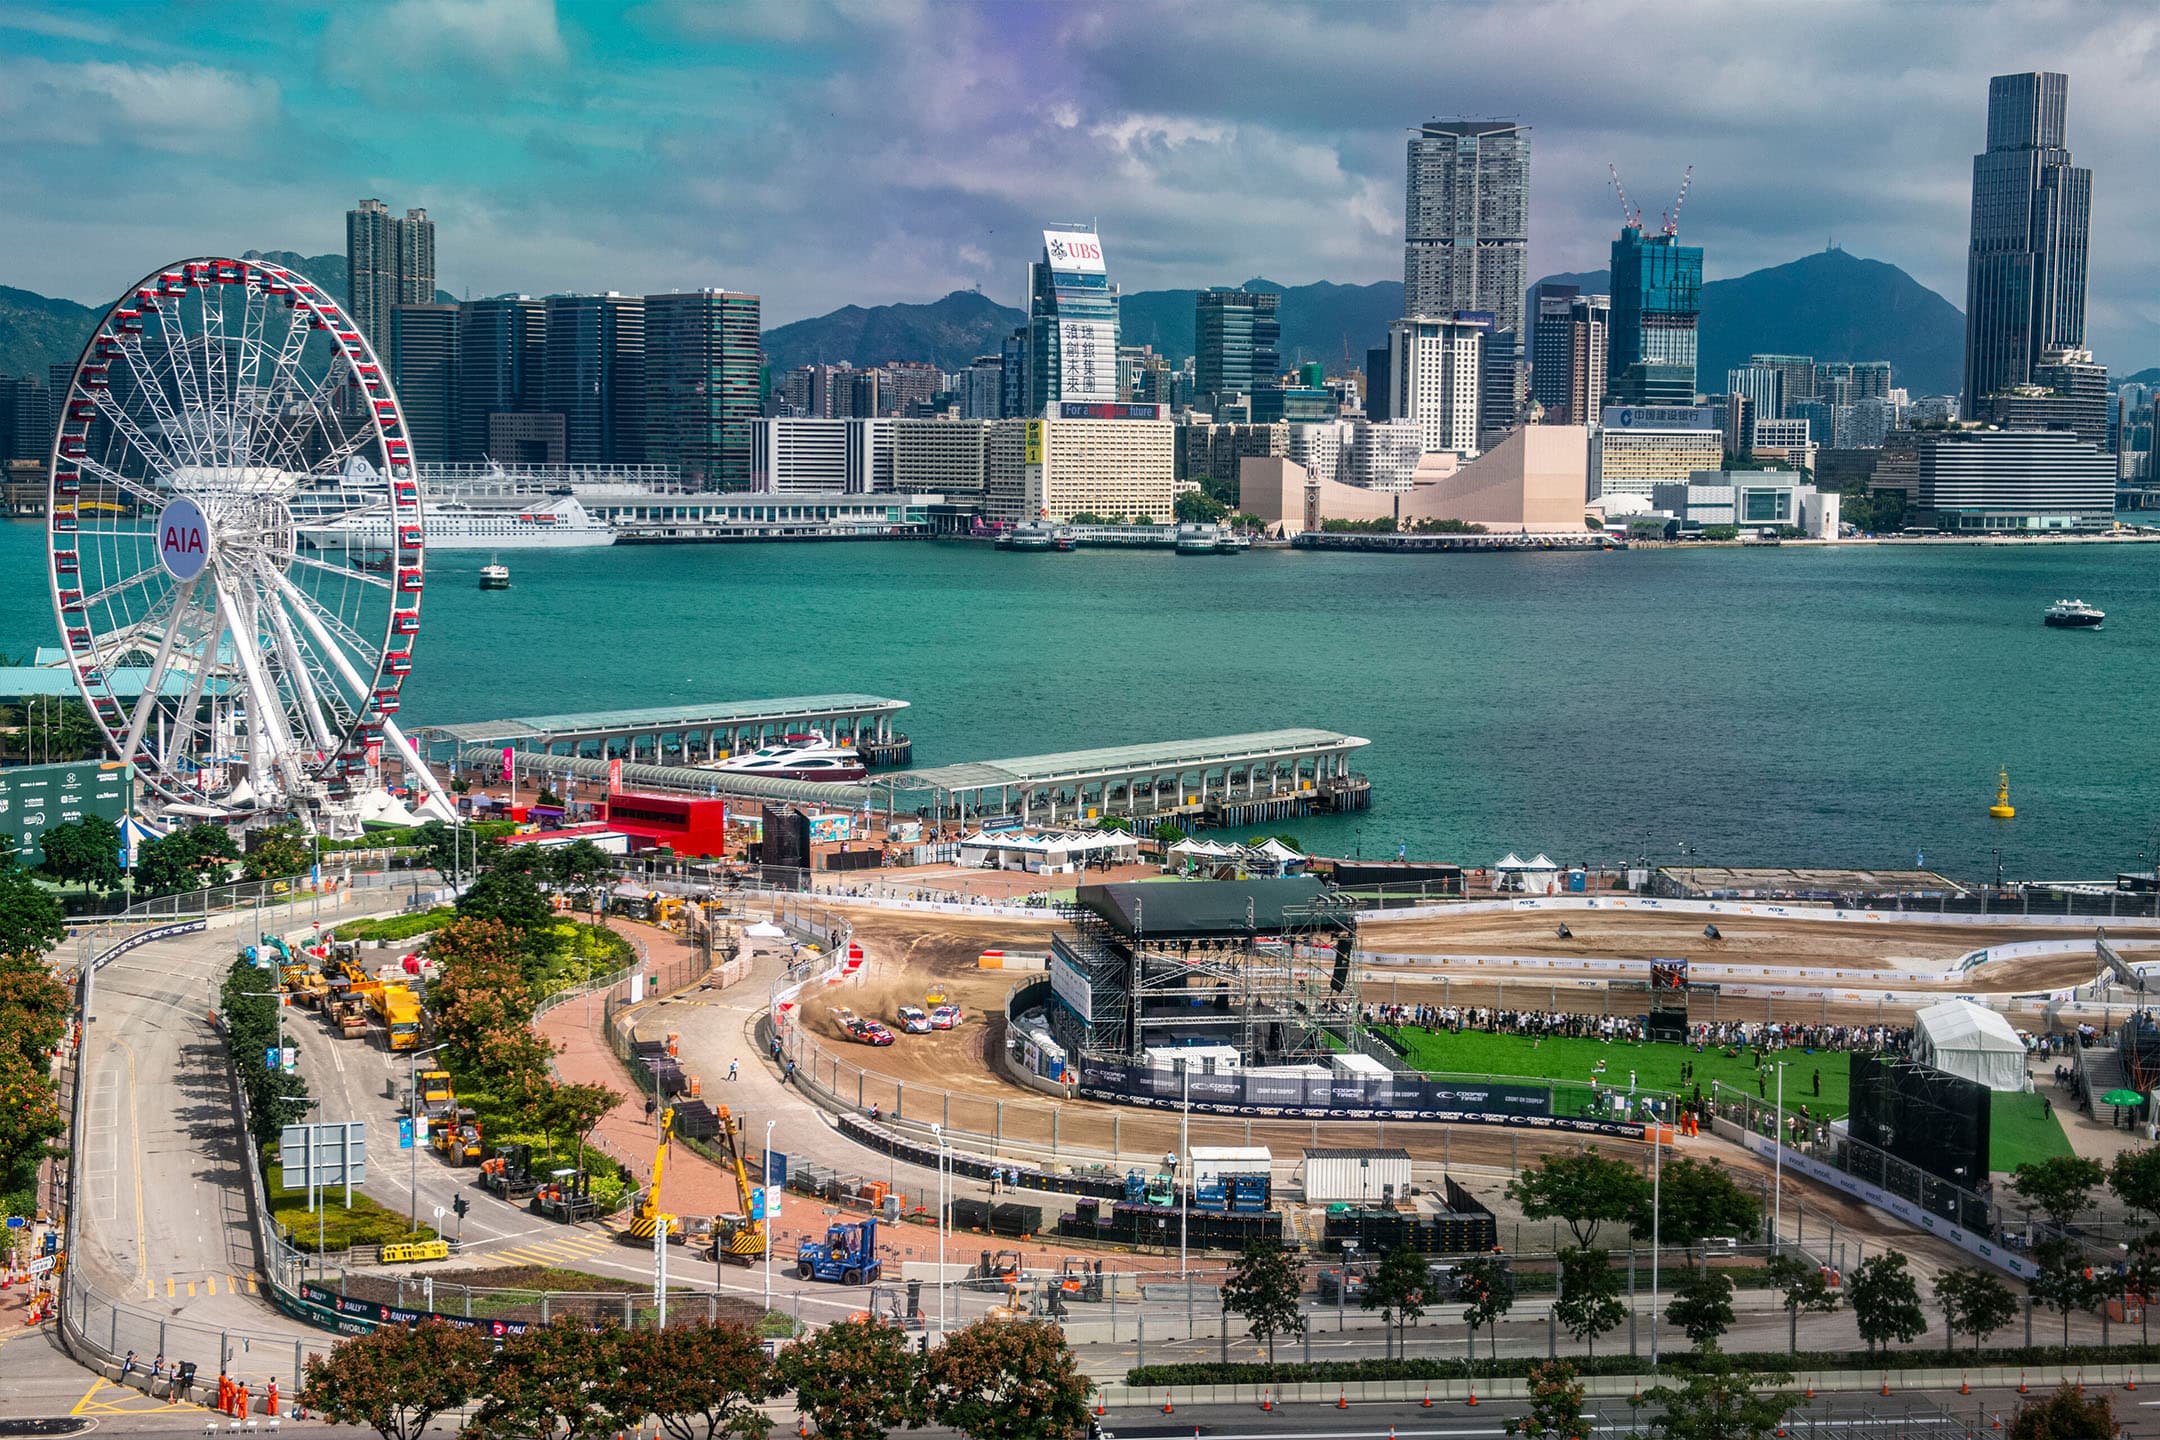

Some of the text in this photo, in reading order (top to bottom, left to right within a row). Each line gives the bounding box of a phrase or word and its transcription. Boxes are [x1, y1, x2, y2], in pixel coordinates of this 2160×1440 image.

[1066, 242, 1100, 260] UBS
[1065, 324, 1079, 392] 領創未來
[1081, 324, 1096, 393] 瑞銀集團
[1066, 404, 1081, 415] For
[1083, 407, 1089, 415] a
[1028, 422, 1039, 431] GP
[1030, 450, 1036, 461] 1
[164, 526, 204, 554] AIA
[1100, 1070, 1126, 1078] COOPER
[1209, 1082, 1240, 1090] COOPER
[1093, 1089, 1115, 1097] COOPER
[1572, 1120, 1599, 1128] COOPER
[1617, 1125, 1644, 1133] COOPER
[344, 1301, 361, 1312] RALLY
[390, 1311, 411, 1322] RALLY
